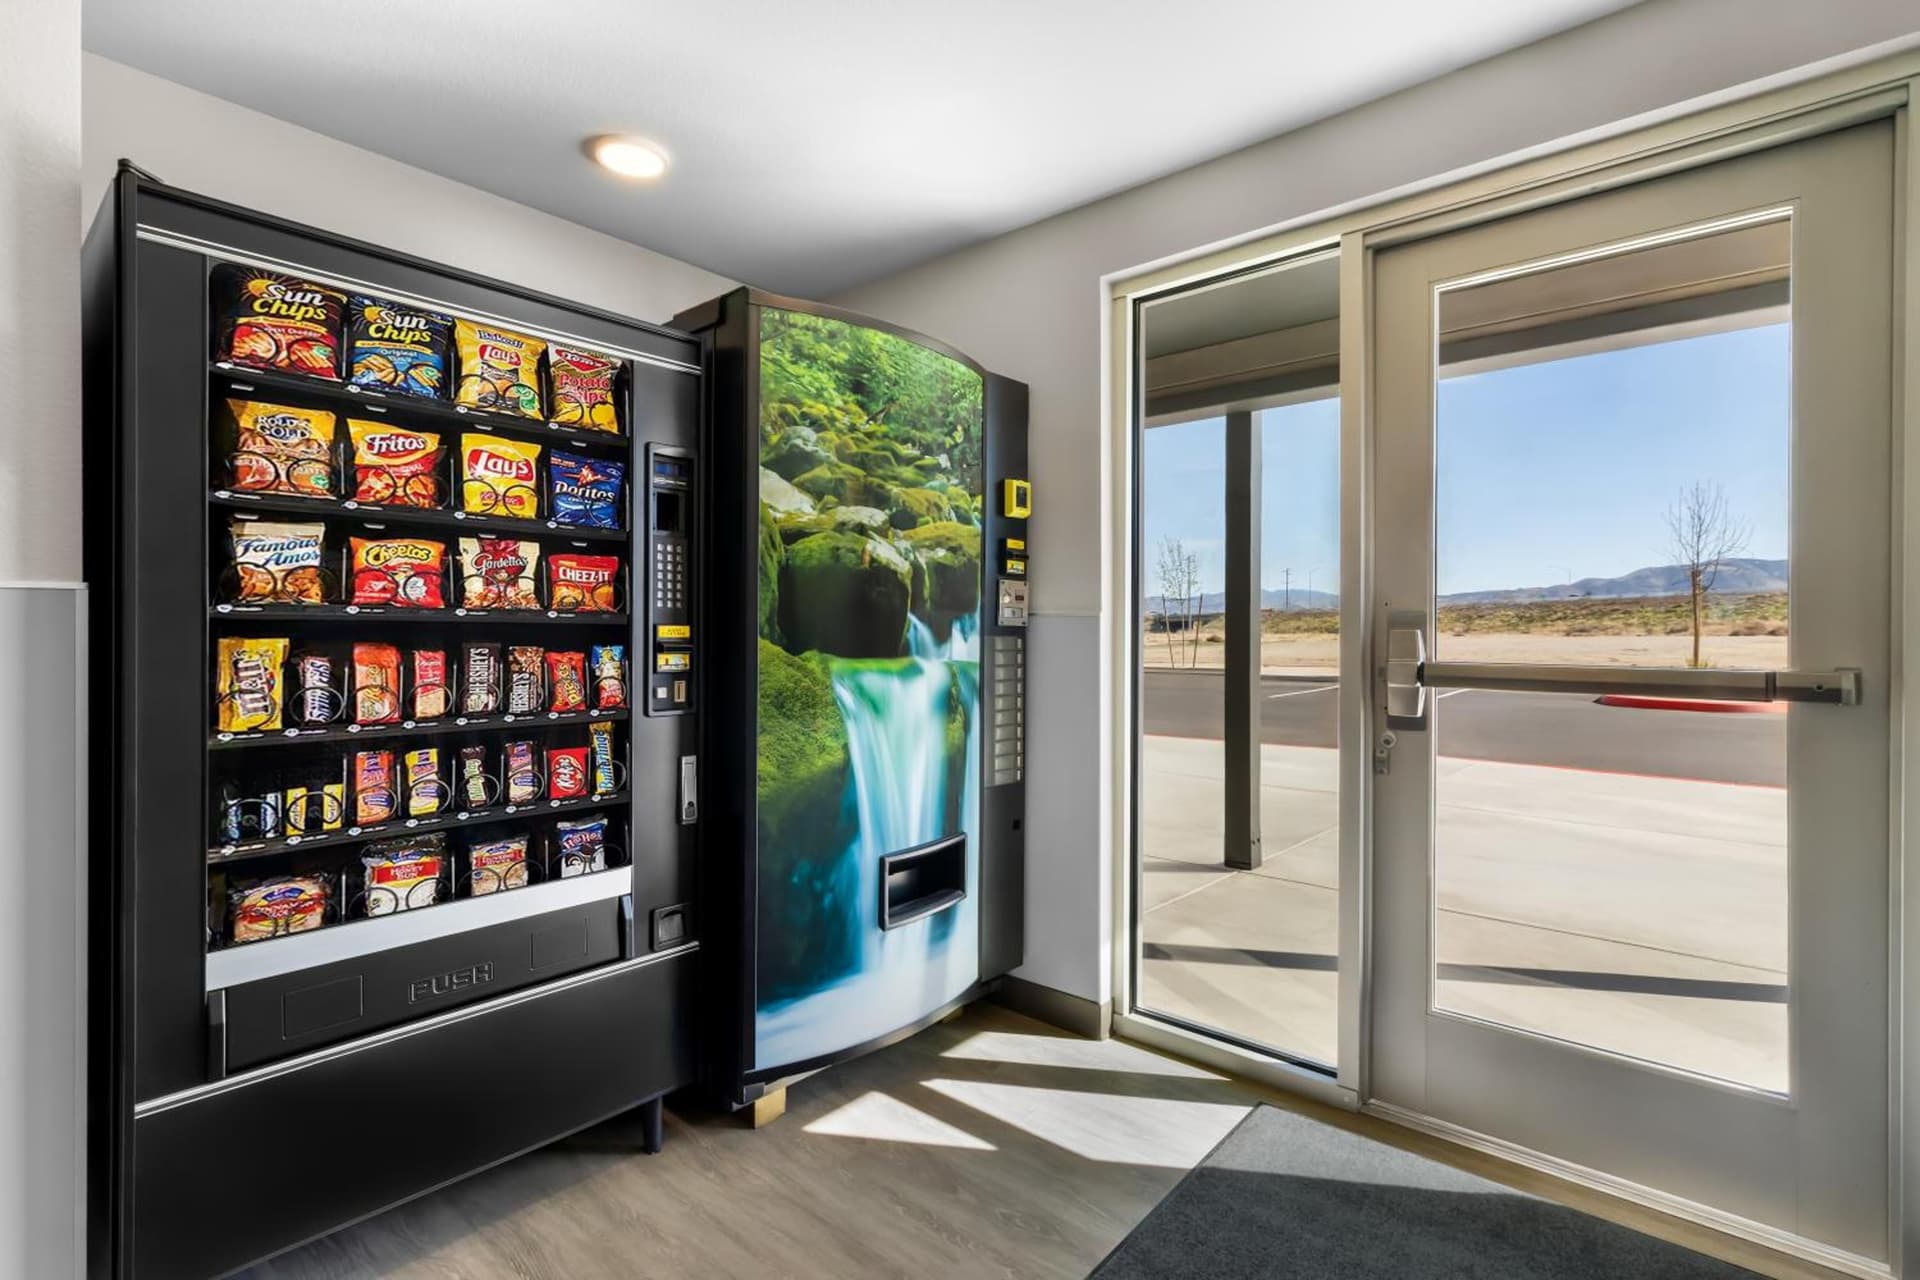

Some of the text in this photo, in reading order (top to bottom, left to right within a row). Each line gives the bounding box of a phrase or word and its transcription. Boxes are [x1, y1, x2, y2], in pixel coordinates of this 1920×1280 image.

[262, 284, 326, 306] Sun
[252, 299, 328, 321] Chips
[376, 310, 430, 330] Sun
[368, 323, 432, 345] Chips
[365, 434, 426, 454] Fritos
[554, 480, 616, 502] Doritos
[235, 538, 320, 559] Famous
[366, 544, 431, 568] Cheetos
[408, 961, 495, 1005] PUSH
